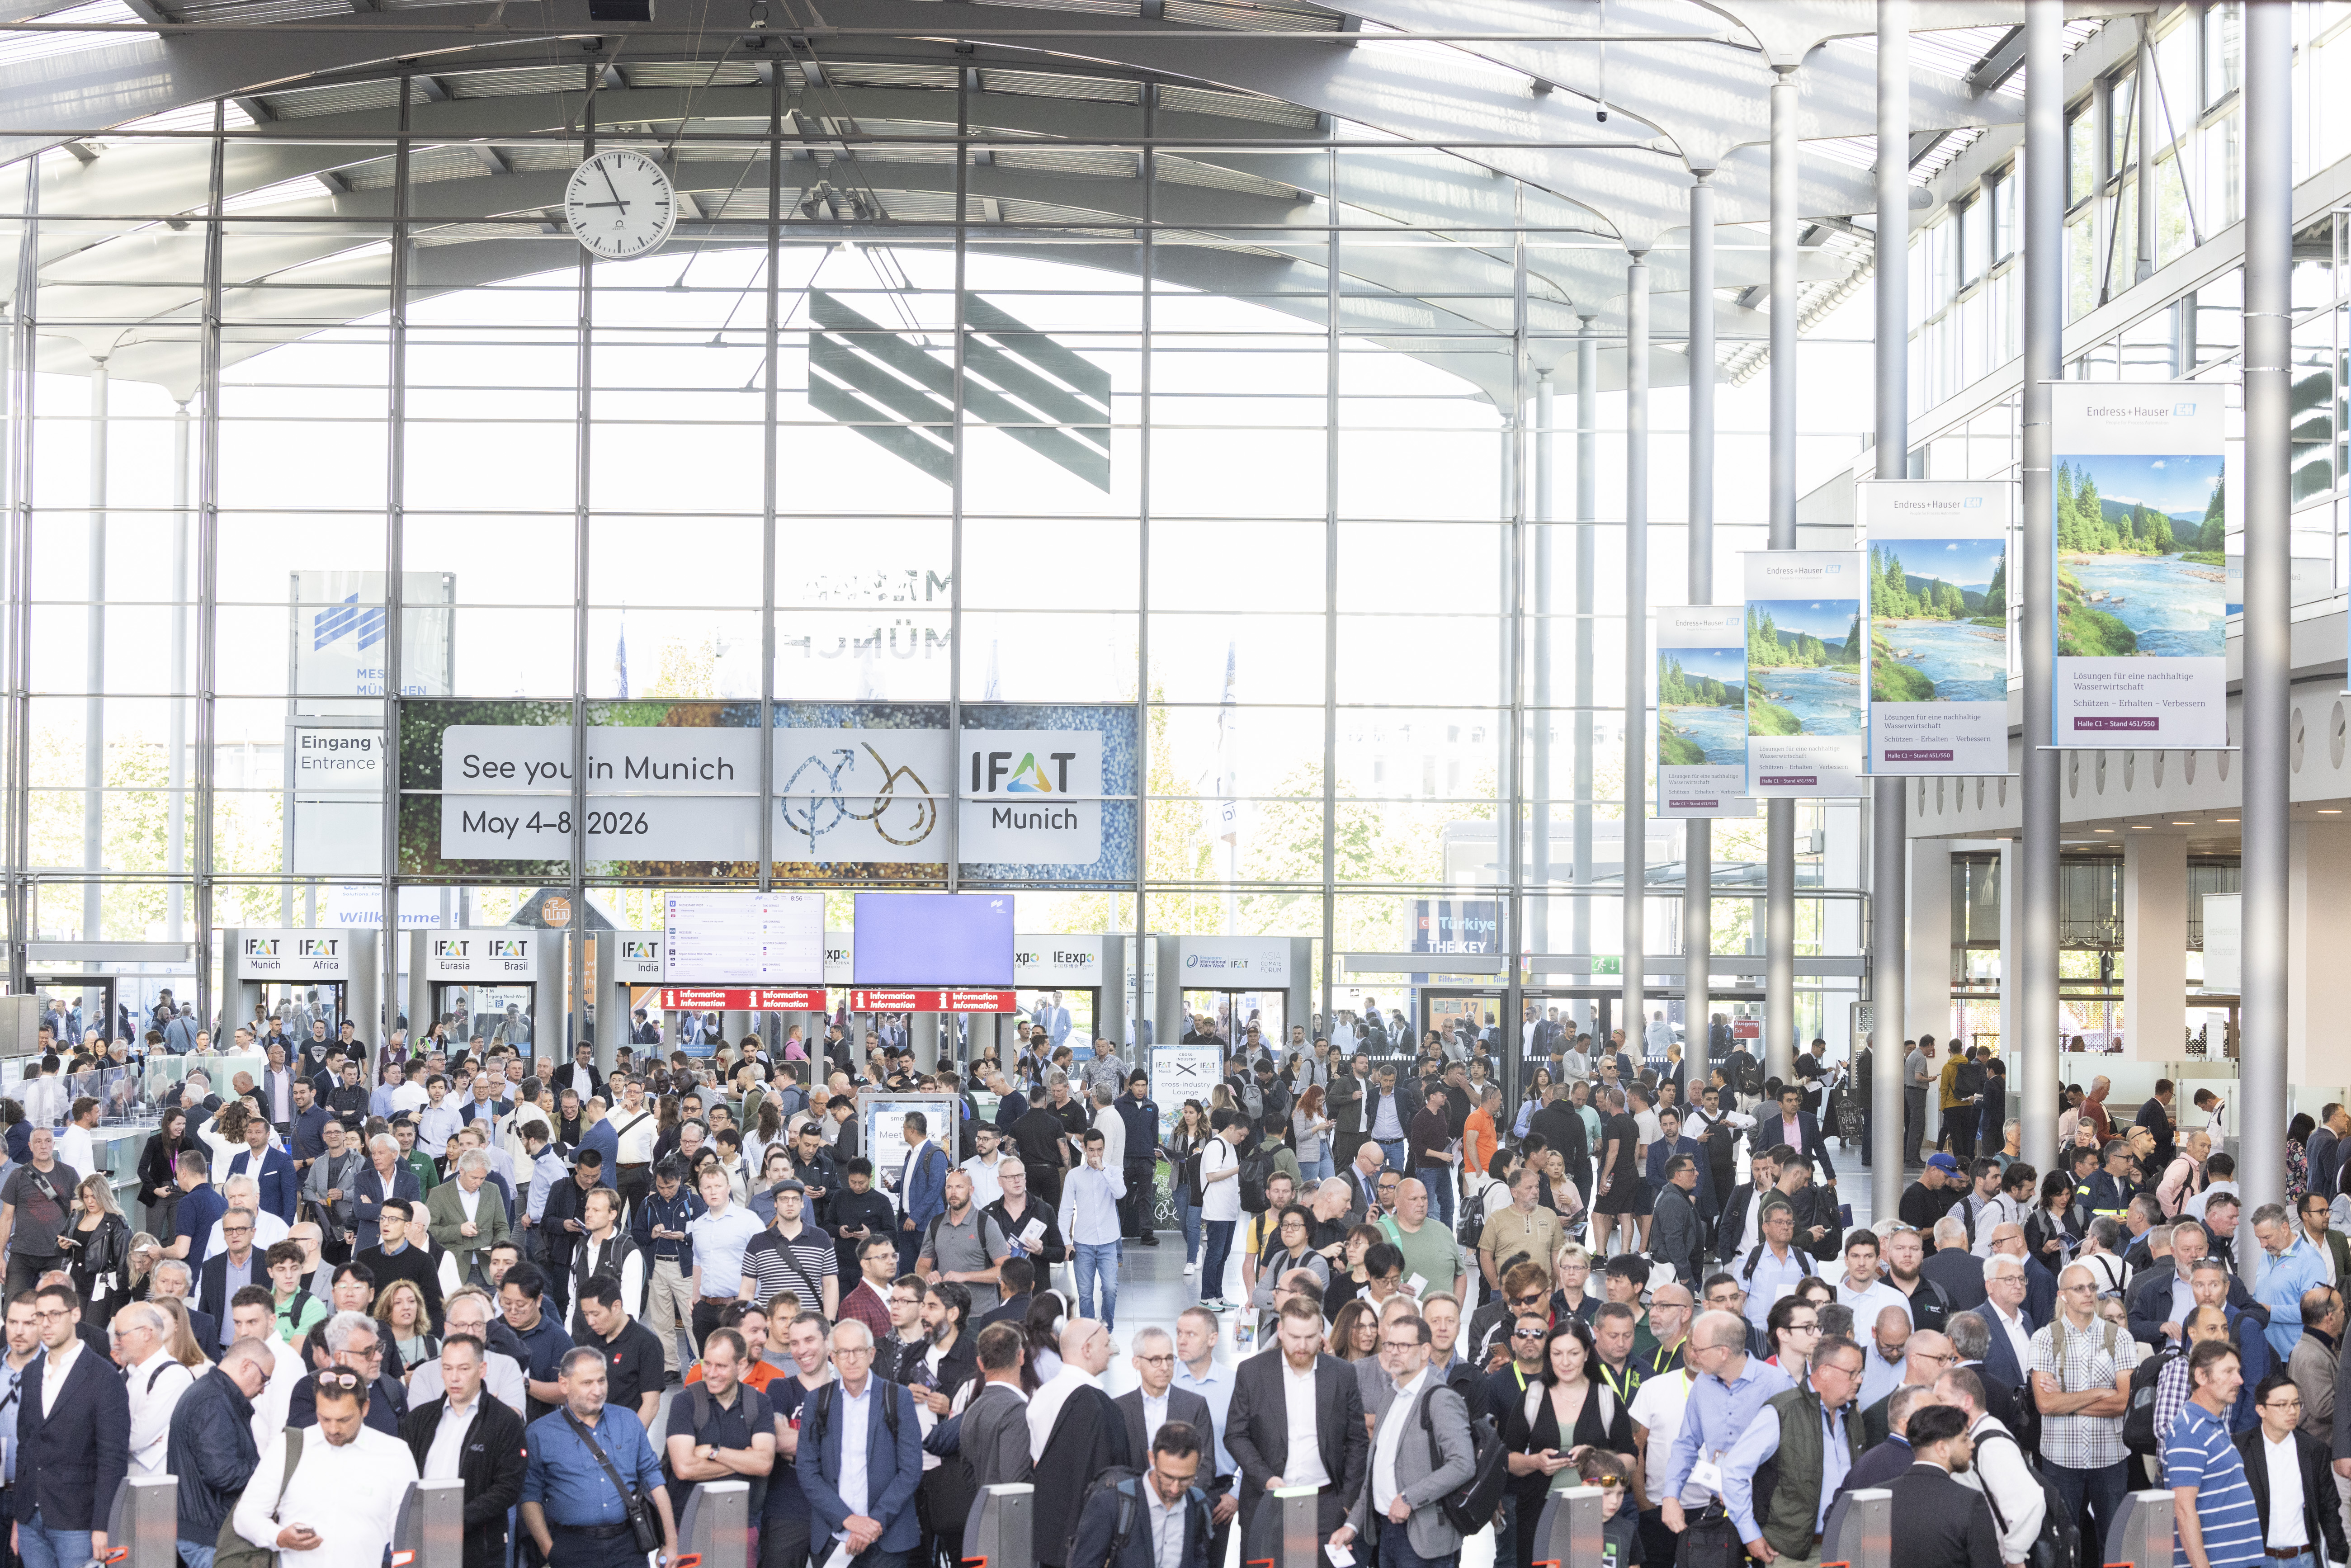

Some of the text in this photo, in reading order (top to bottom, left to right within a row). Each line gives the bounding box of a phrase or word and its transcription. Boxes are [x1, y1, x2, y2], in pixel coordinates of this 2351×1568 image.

[2087, 406, 2169, 416] Endress+Hauser
[1894, 500, 1960, 509] Endress+Hauser
[357, 669, 384, 679] MES
[2074, 672, 2111, 681] Lösungen
[2147, 672, 2193, 681] nachhaltige
[357, 683, 427, 695] MÜNHEN
[302, 736, 371, 751] Eingang
[302, 756, 375, 769] Entrance
[463, 754, 734, 785] See you in Munich
[972, 751, 1076, 793] IFAT
[992, 807, 1077, 830] Munich
[463, 810, 649, 840] May 4–8 2026
[340, 912, 458, 923] Willkmme!
[1440, 916, 1496, 933] Türkiye
[245, 939, 338, 955] IFAT IFAT
[435, 940, 527, 956] IFAT IFAT
[623, 942, 658, 958] IFAT
[1427, 941, 1487, 953] THE KEY
[251, 960, 339, 969] Munich Africa
[441, 961, 528, 970] Eurasia Brasil
[638, 963, 659, 972] India
[1841, 1116, 1857, 1124] OPEN
